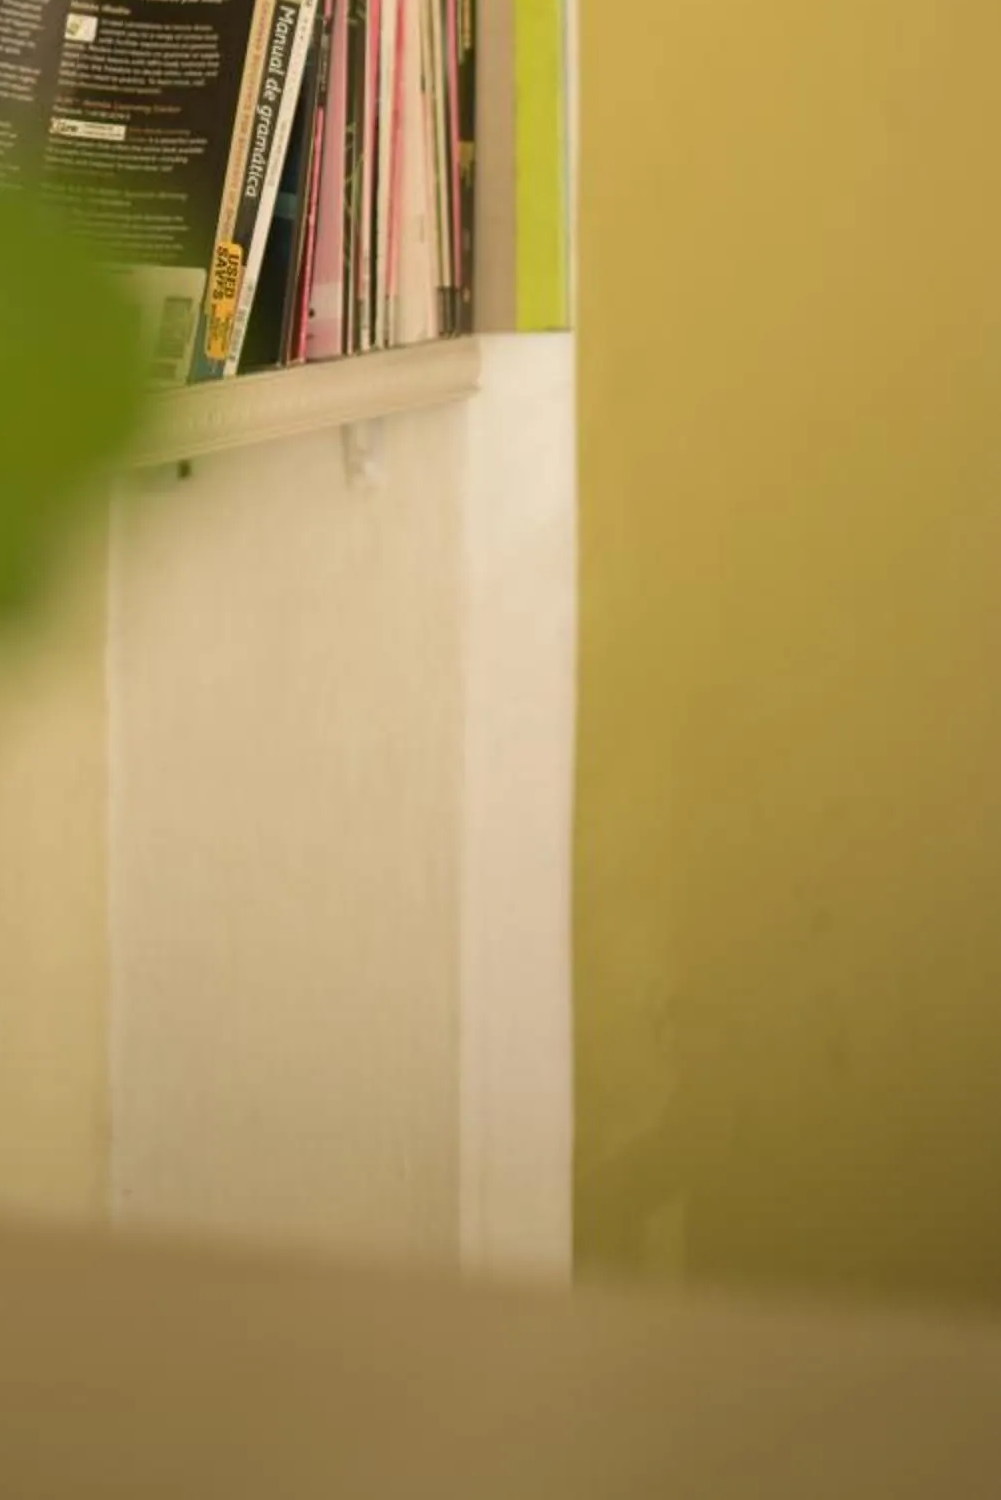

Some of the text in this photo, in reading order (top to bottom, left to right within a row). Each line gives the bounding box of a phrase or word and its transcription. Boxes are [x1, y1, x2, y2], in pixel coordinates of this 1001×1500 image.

[245, 5, 297, 198] Manual de gramática
[212, 245, 229, 300] SAVES
[224, 254, 241, 300] USED
